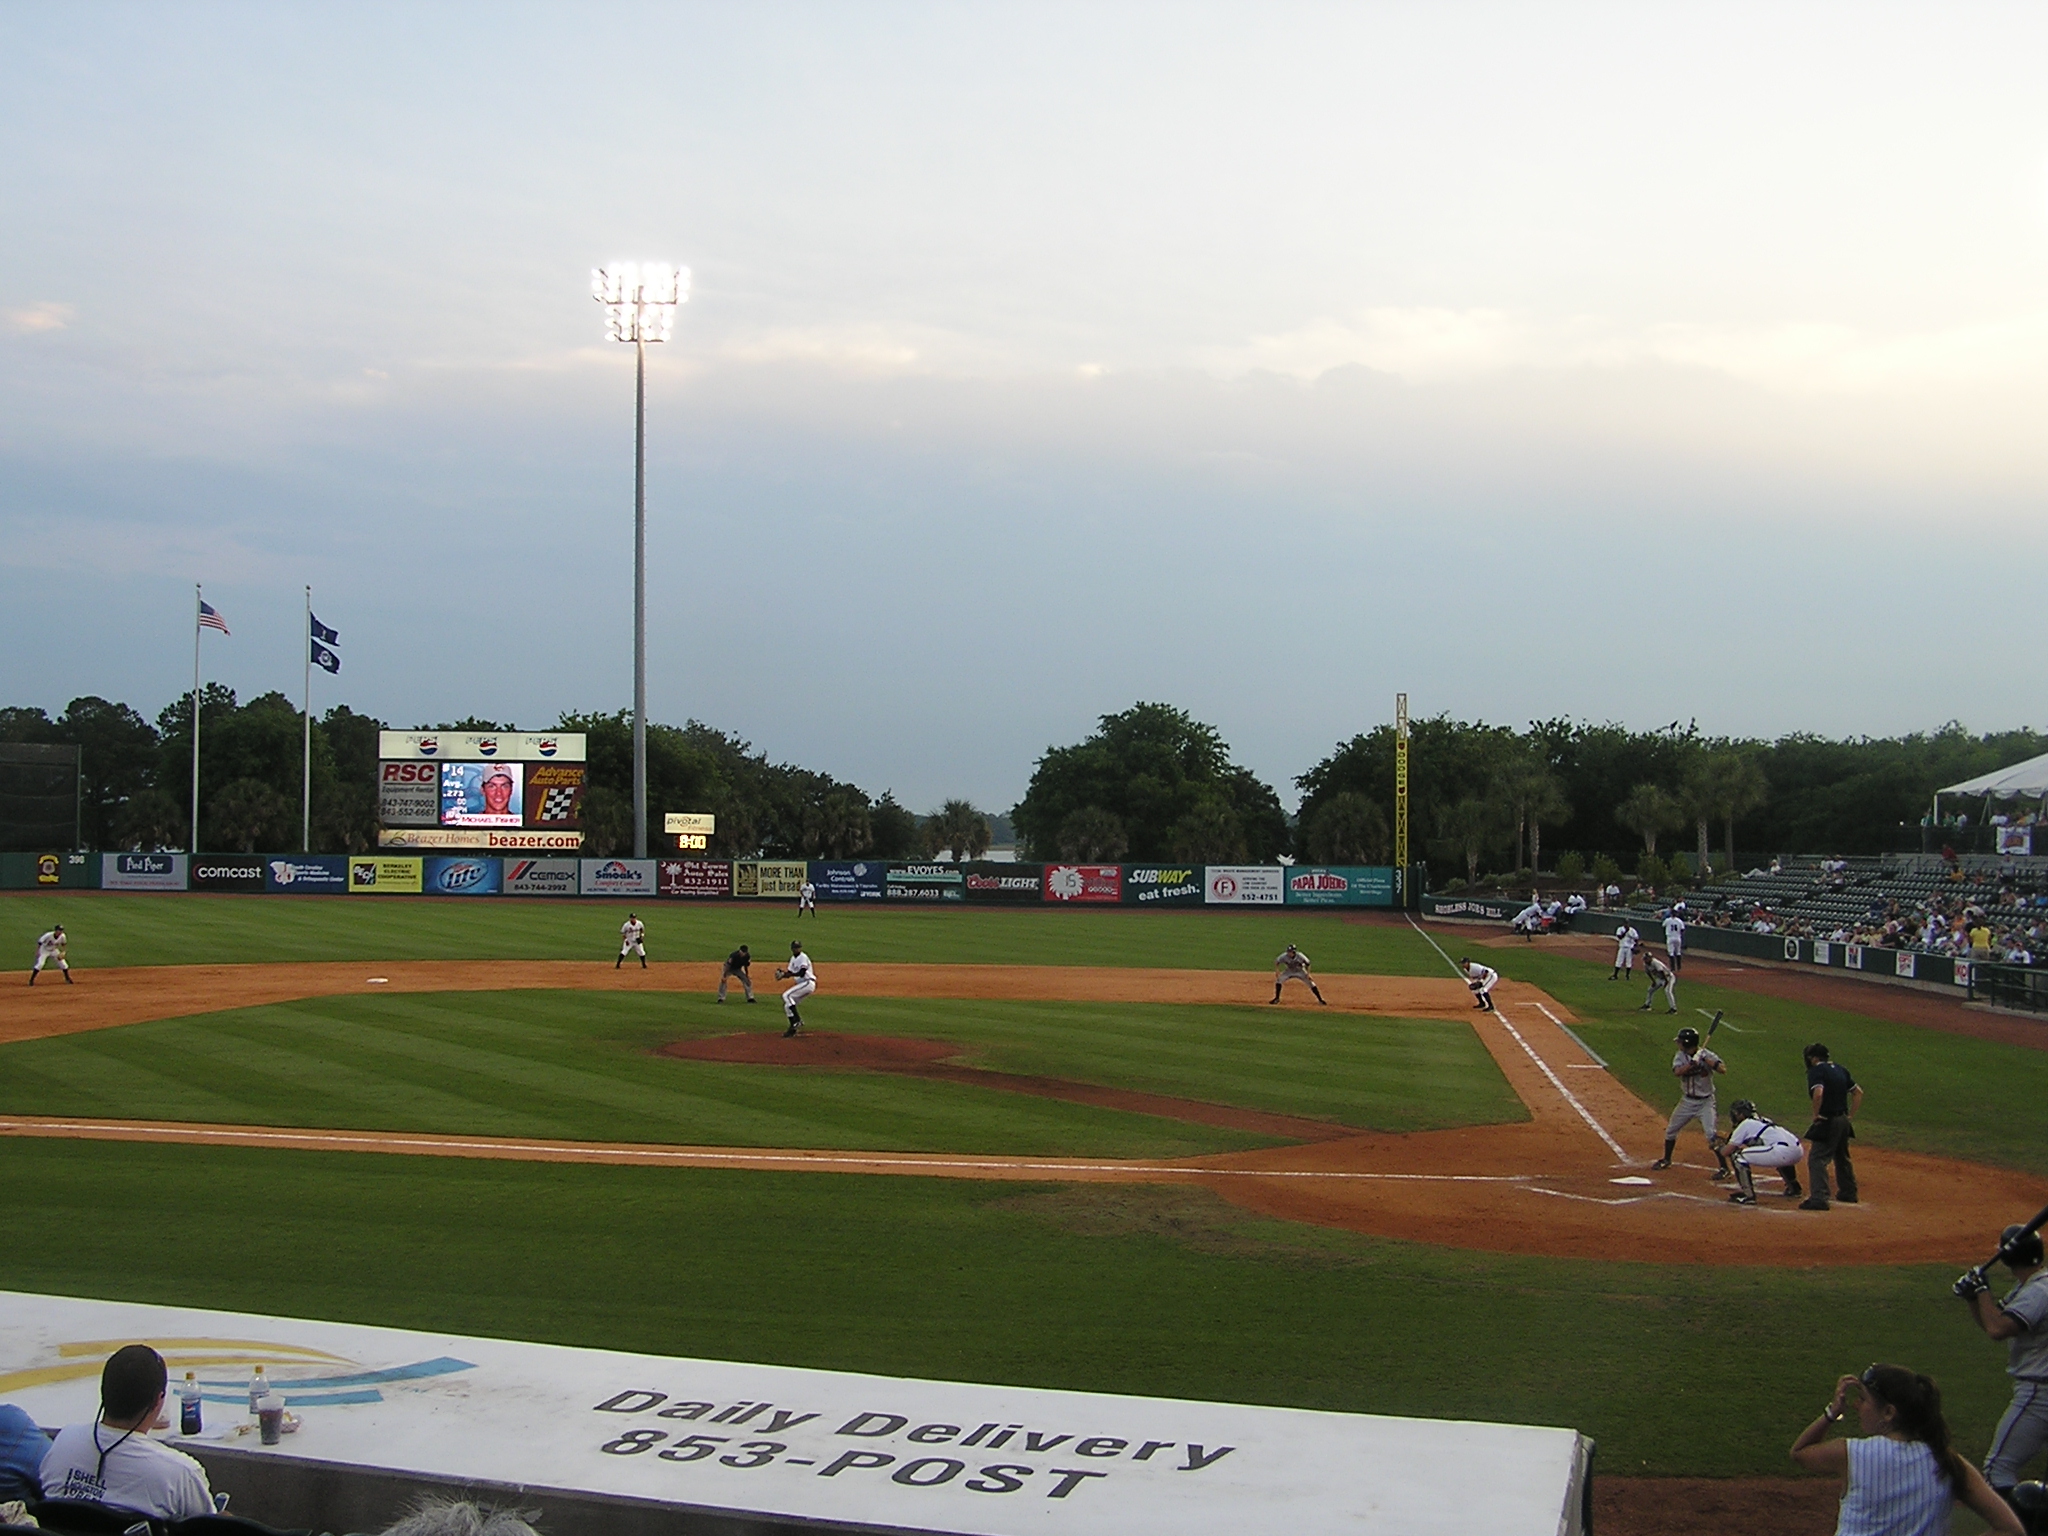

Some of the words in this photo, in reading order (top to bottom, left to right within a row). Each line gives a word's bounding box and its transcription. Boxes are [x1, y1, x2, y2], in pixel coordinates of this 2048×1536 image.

[383, 764, 435, 782] RSC
[451, 766, 464, 777] 14
[537, 766, 584, 776] Advance
[489, 832, 580, 847] beazer.com
[198, 866, 262, 878] comcast
[529, 871, 576, 881] CEMEX
[595, 869, 642, 880] Smoak's
[760, 867, 782, 878] MORE
[784, 867, 804, 878] THAN
[1128, 869, 1192, 884] SUBWAY
[1000, 877, 1039, 890] LIGHT
[1292, 876, 1315, 890] PAPA
[1138, 891, 1160, 901] eat
[593, 1390, 822, 1434] Daily
[834, 1411, 1236, 1471] Delivery
[600, 1429, 1108, 1499] 853-POST
[74, 1469, 107, 1490] SHELL
